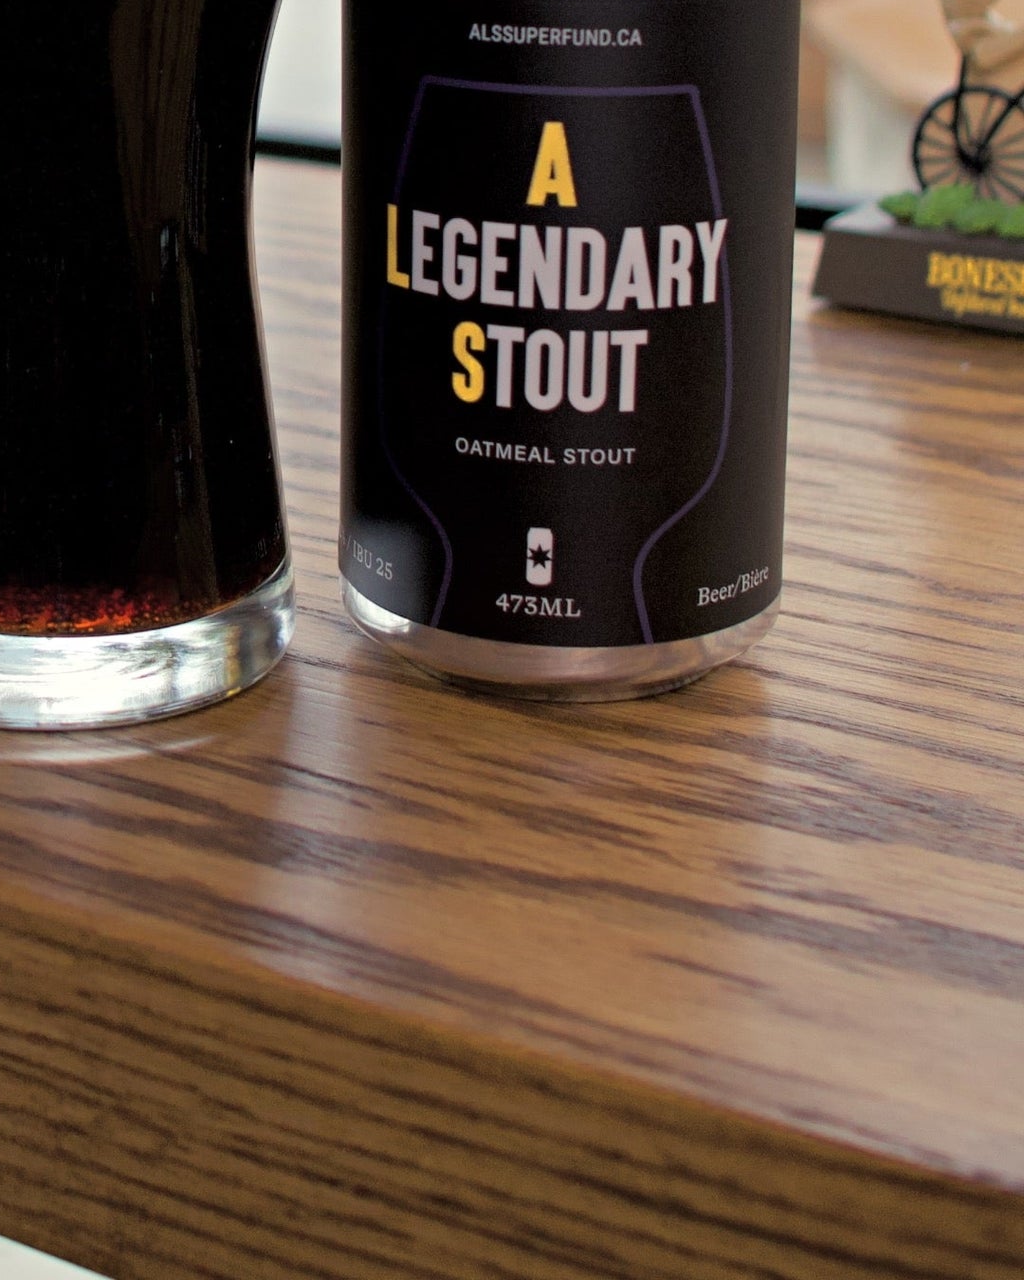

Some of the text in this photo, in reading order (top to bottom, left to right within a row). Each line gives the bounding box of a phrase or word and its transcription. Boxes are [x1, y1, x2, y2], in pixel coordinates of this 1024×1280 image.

[468, 22, 643, 47] ALSSUPERFUND.CA
[526, 120, 577, 207] A
[386, 202, 728, 312] LEGENDARY
[451, 320, 649, 414] STOUT
[455, 436, 637, 465] OATMEAL STOUT
[352, 539, 373, 569] IBU
[375, 557, 394, 581] 25
[494, 593, 582, 618] 473ML
